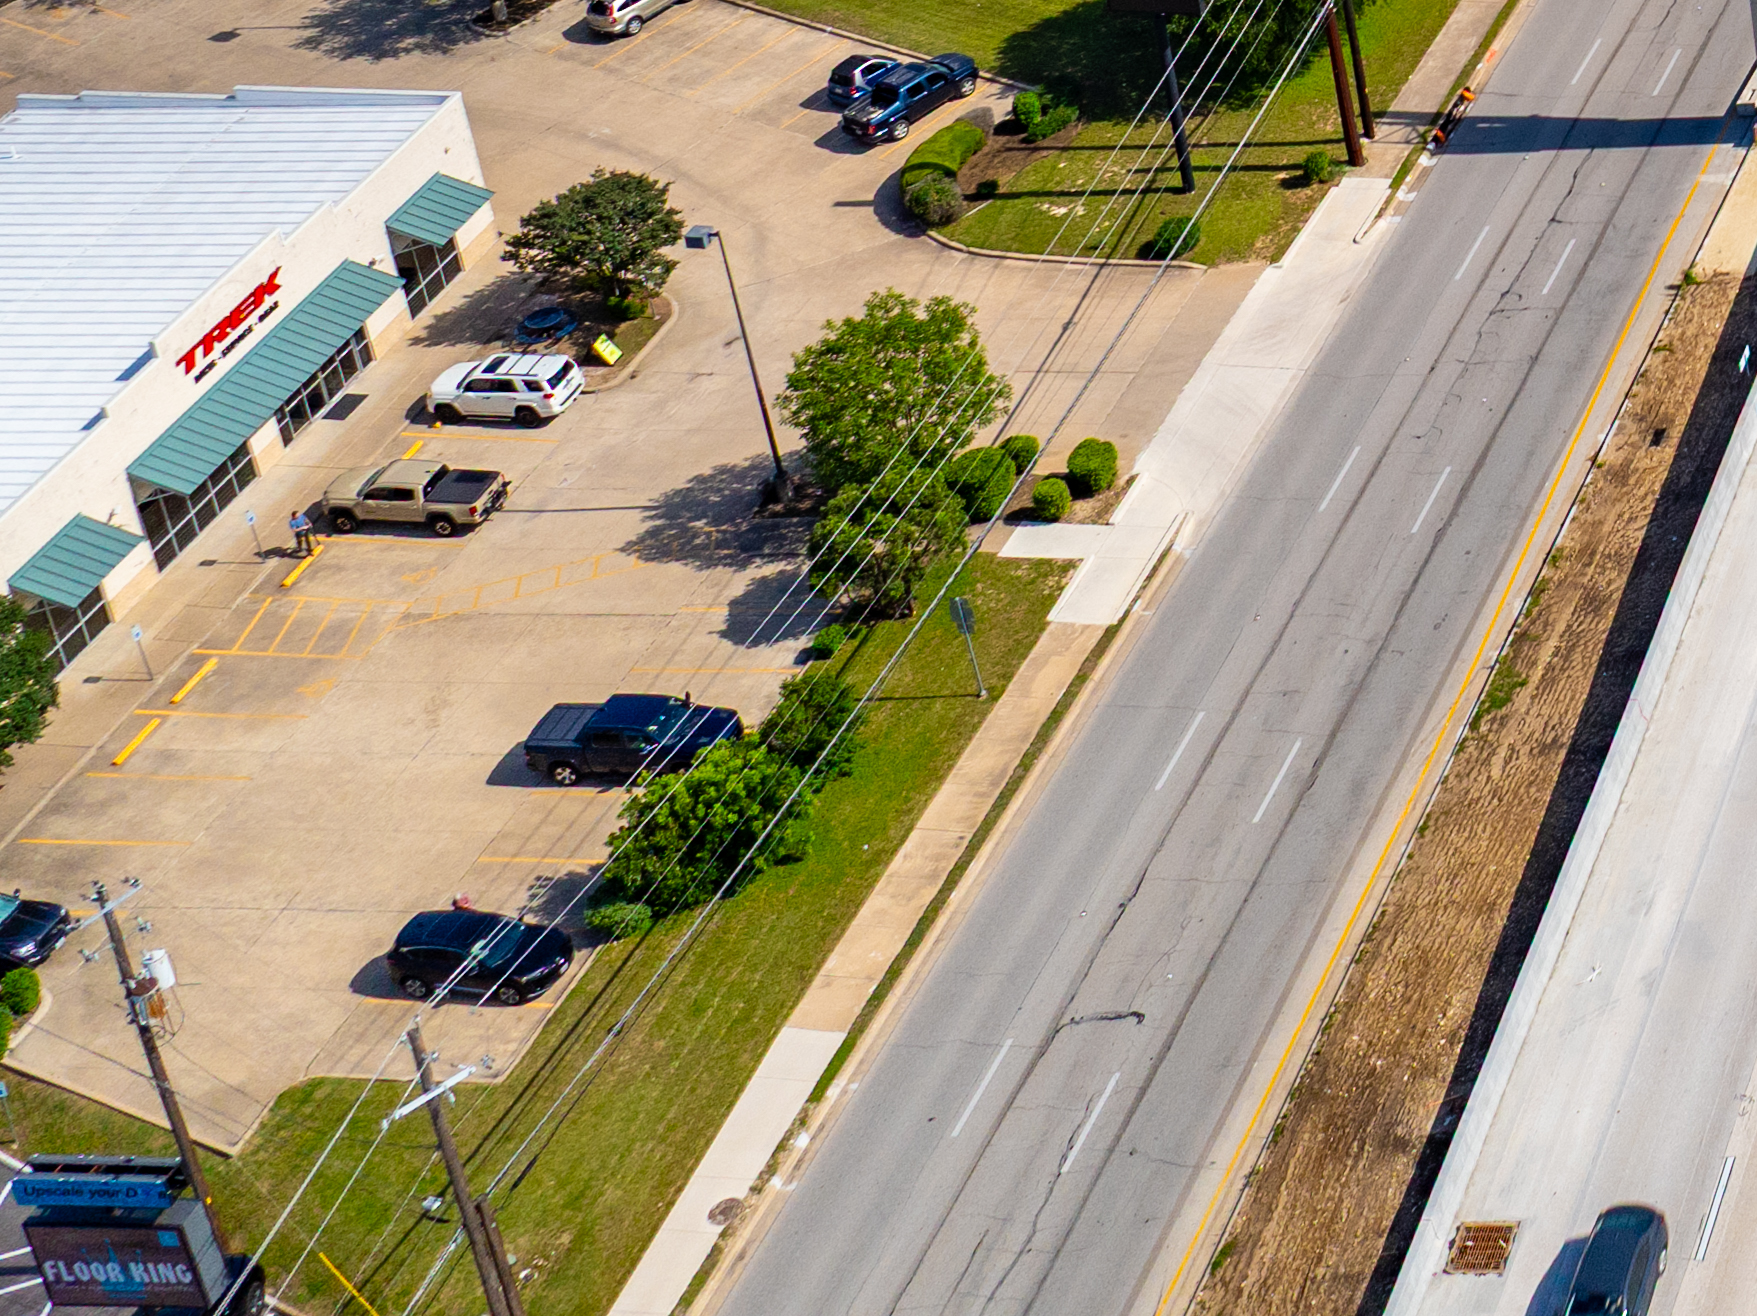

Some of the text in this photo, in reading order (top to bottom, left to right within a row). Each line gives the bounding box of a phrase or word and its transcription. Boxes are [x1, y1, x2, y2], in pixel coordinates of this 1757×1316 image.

[175, 265, 283, 375] TREK
[24, 1185, 84, 1198] Upscale
[88, 1187, 121, 1201] your
[42, 1260, 193, 1284] FLOOR KING
